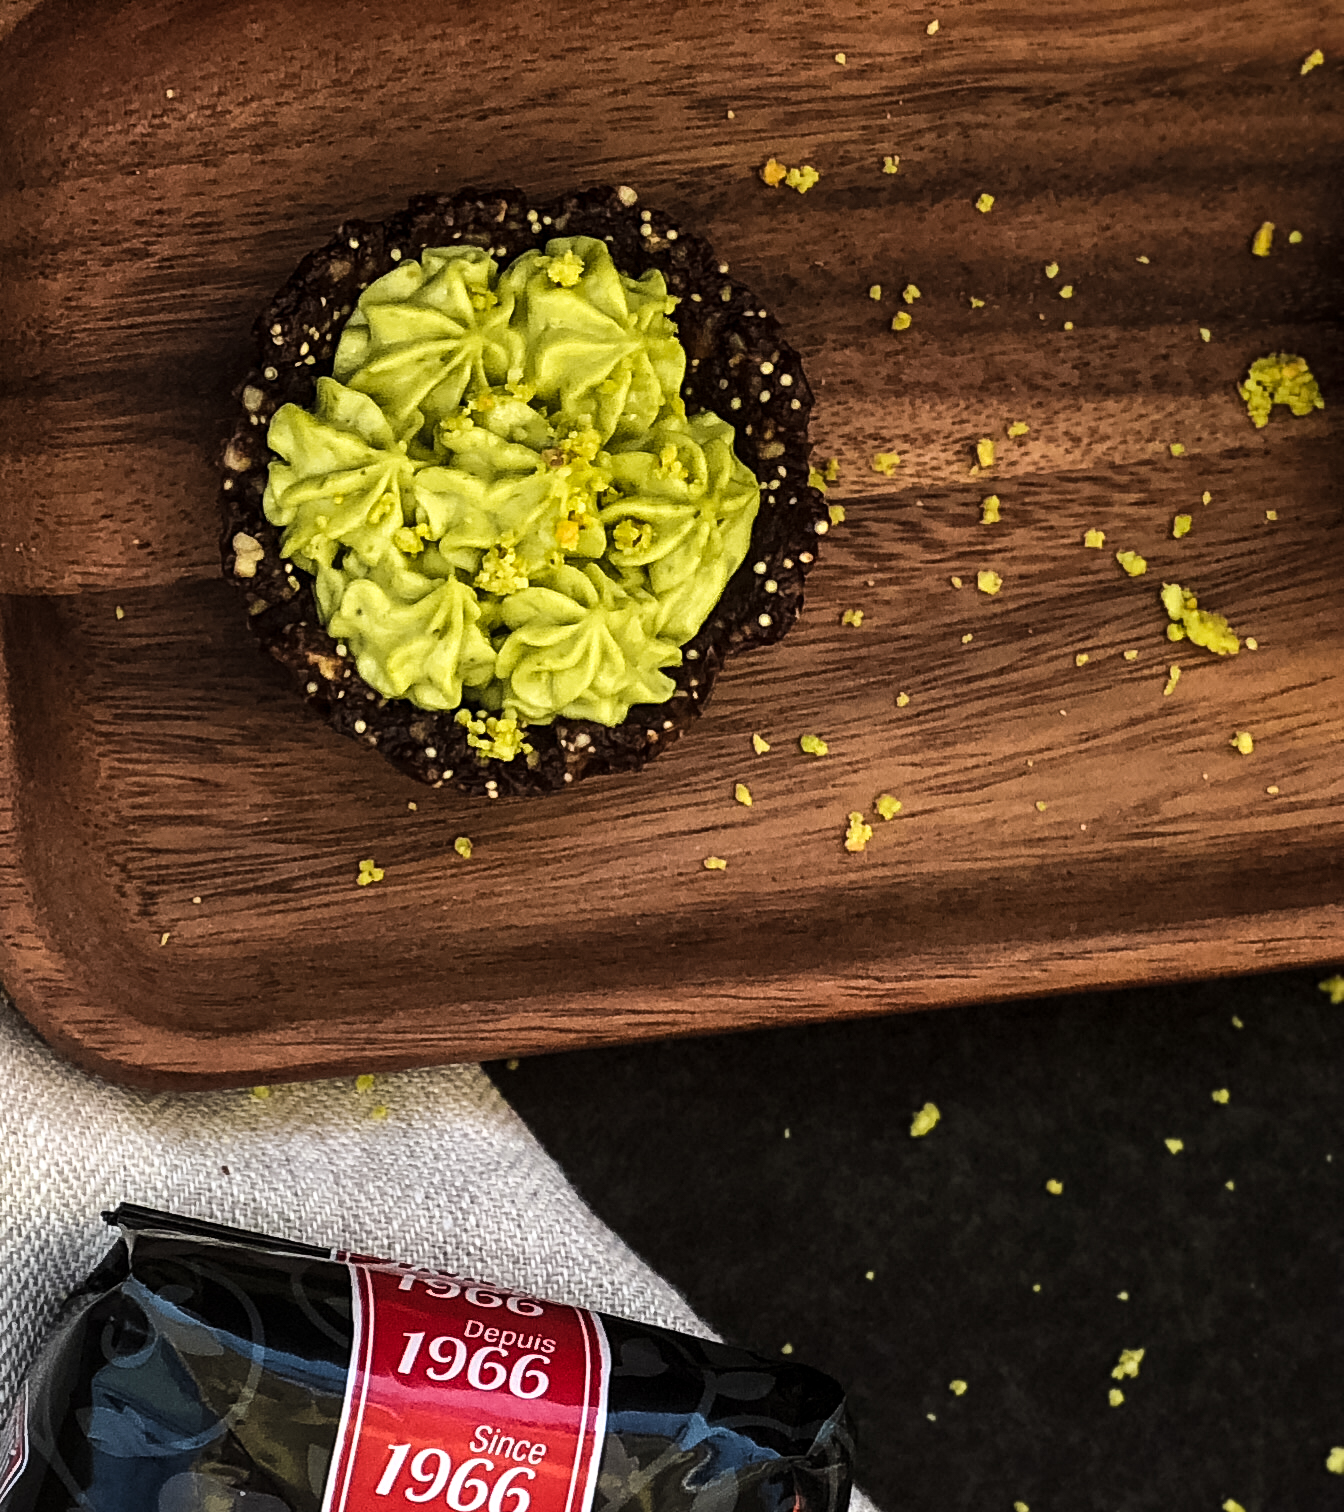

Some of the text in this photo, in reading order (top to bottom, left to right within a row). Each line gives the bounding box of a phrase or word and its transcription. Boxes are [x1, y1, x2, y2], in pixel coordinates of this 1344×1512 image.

[463, 1319, 557, 1354] Depuis
[396, 1330, 552, 1400] 1966
[469, 1424, 548, 1465] Since
